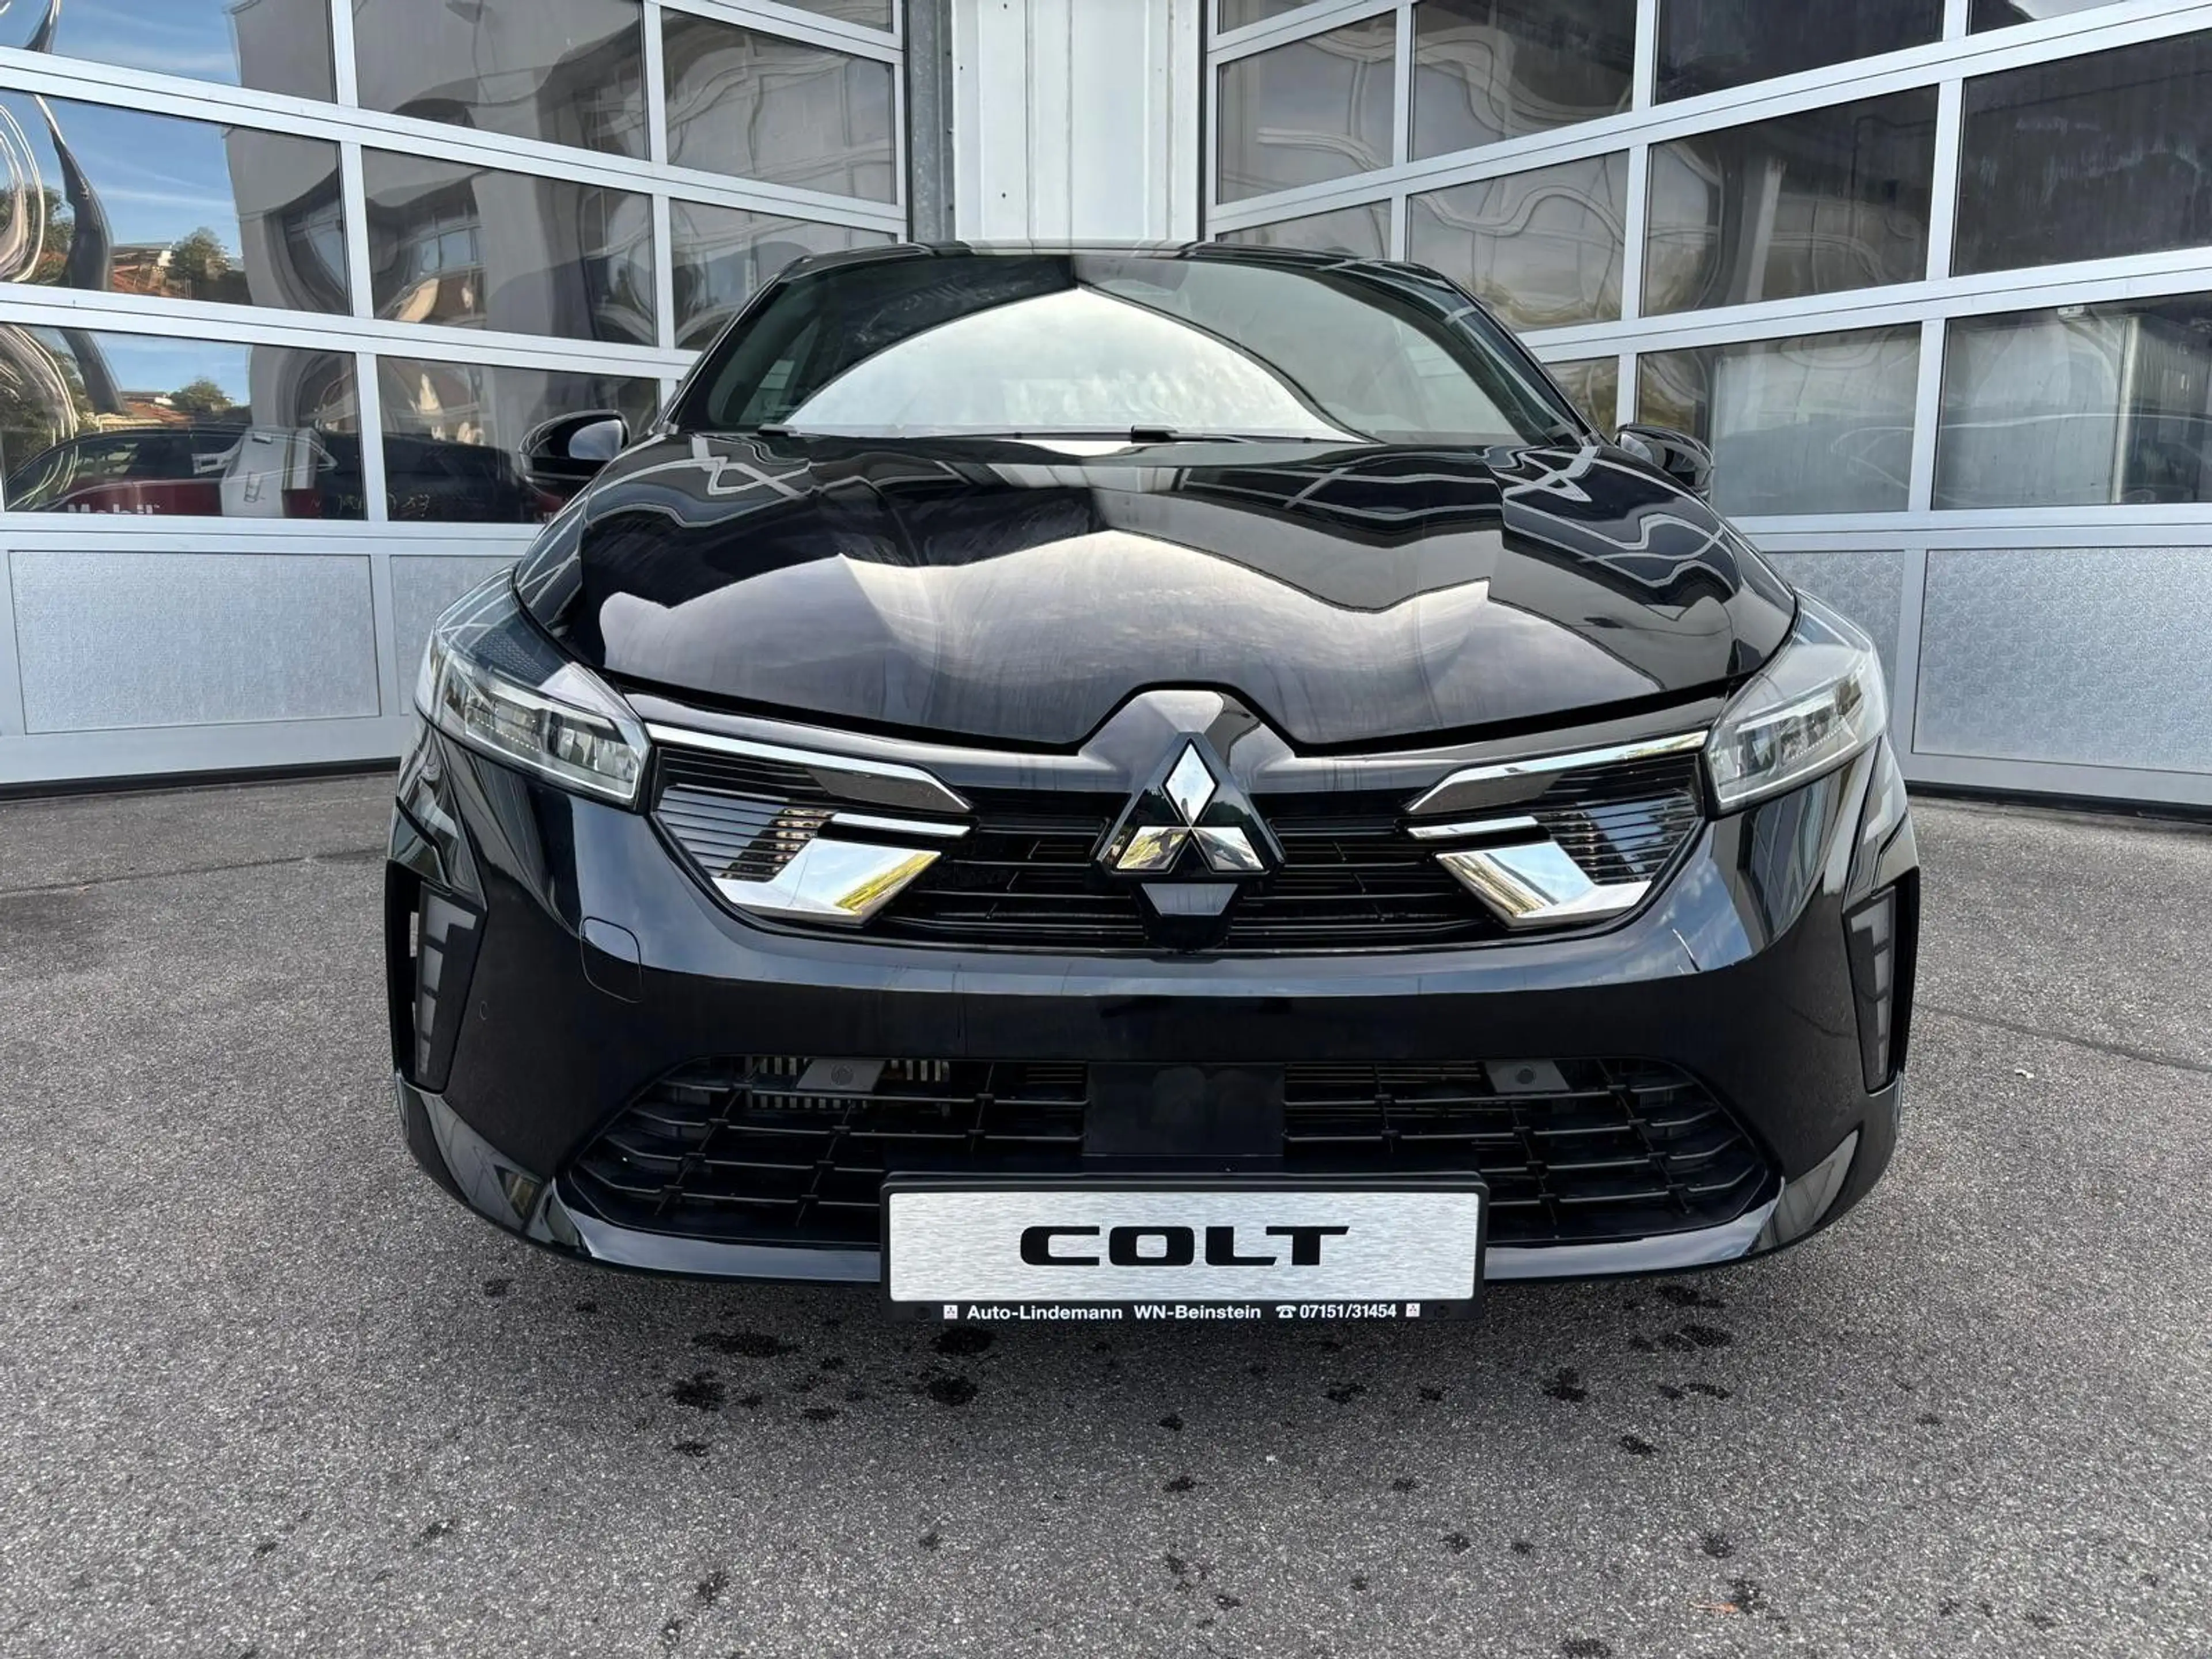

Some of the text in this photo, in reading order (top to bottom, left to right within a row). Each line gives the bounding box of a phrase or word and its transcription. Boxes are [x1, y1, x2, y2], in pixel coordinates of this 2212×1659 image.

[1020, 1226, 1350, 1267] COLT
[967, 1303, 1397, 1320] Auto-Lindemann WN-Beinstein 07151/31454
